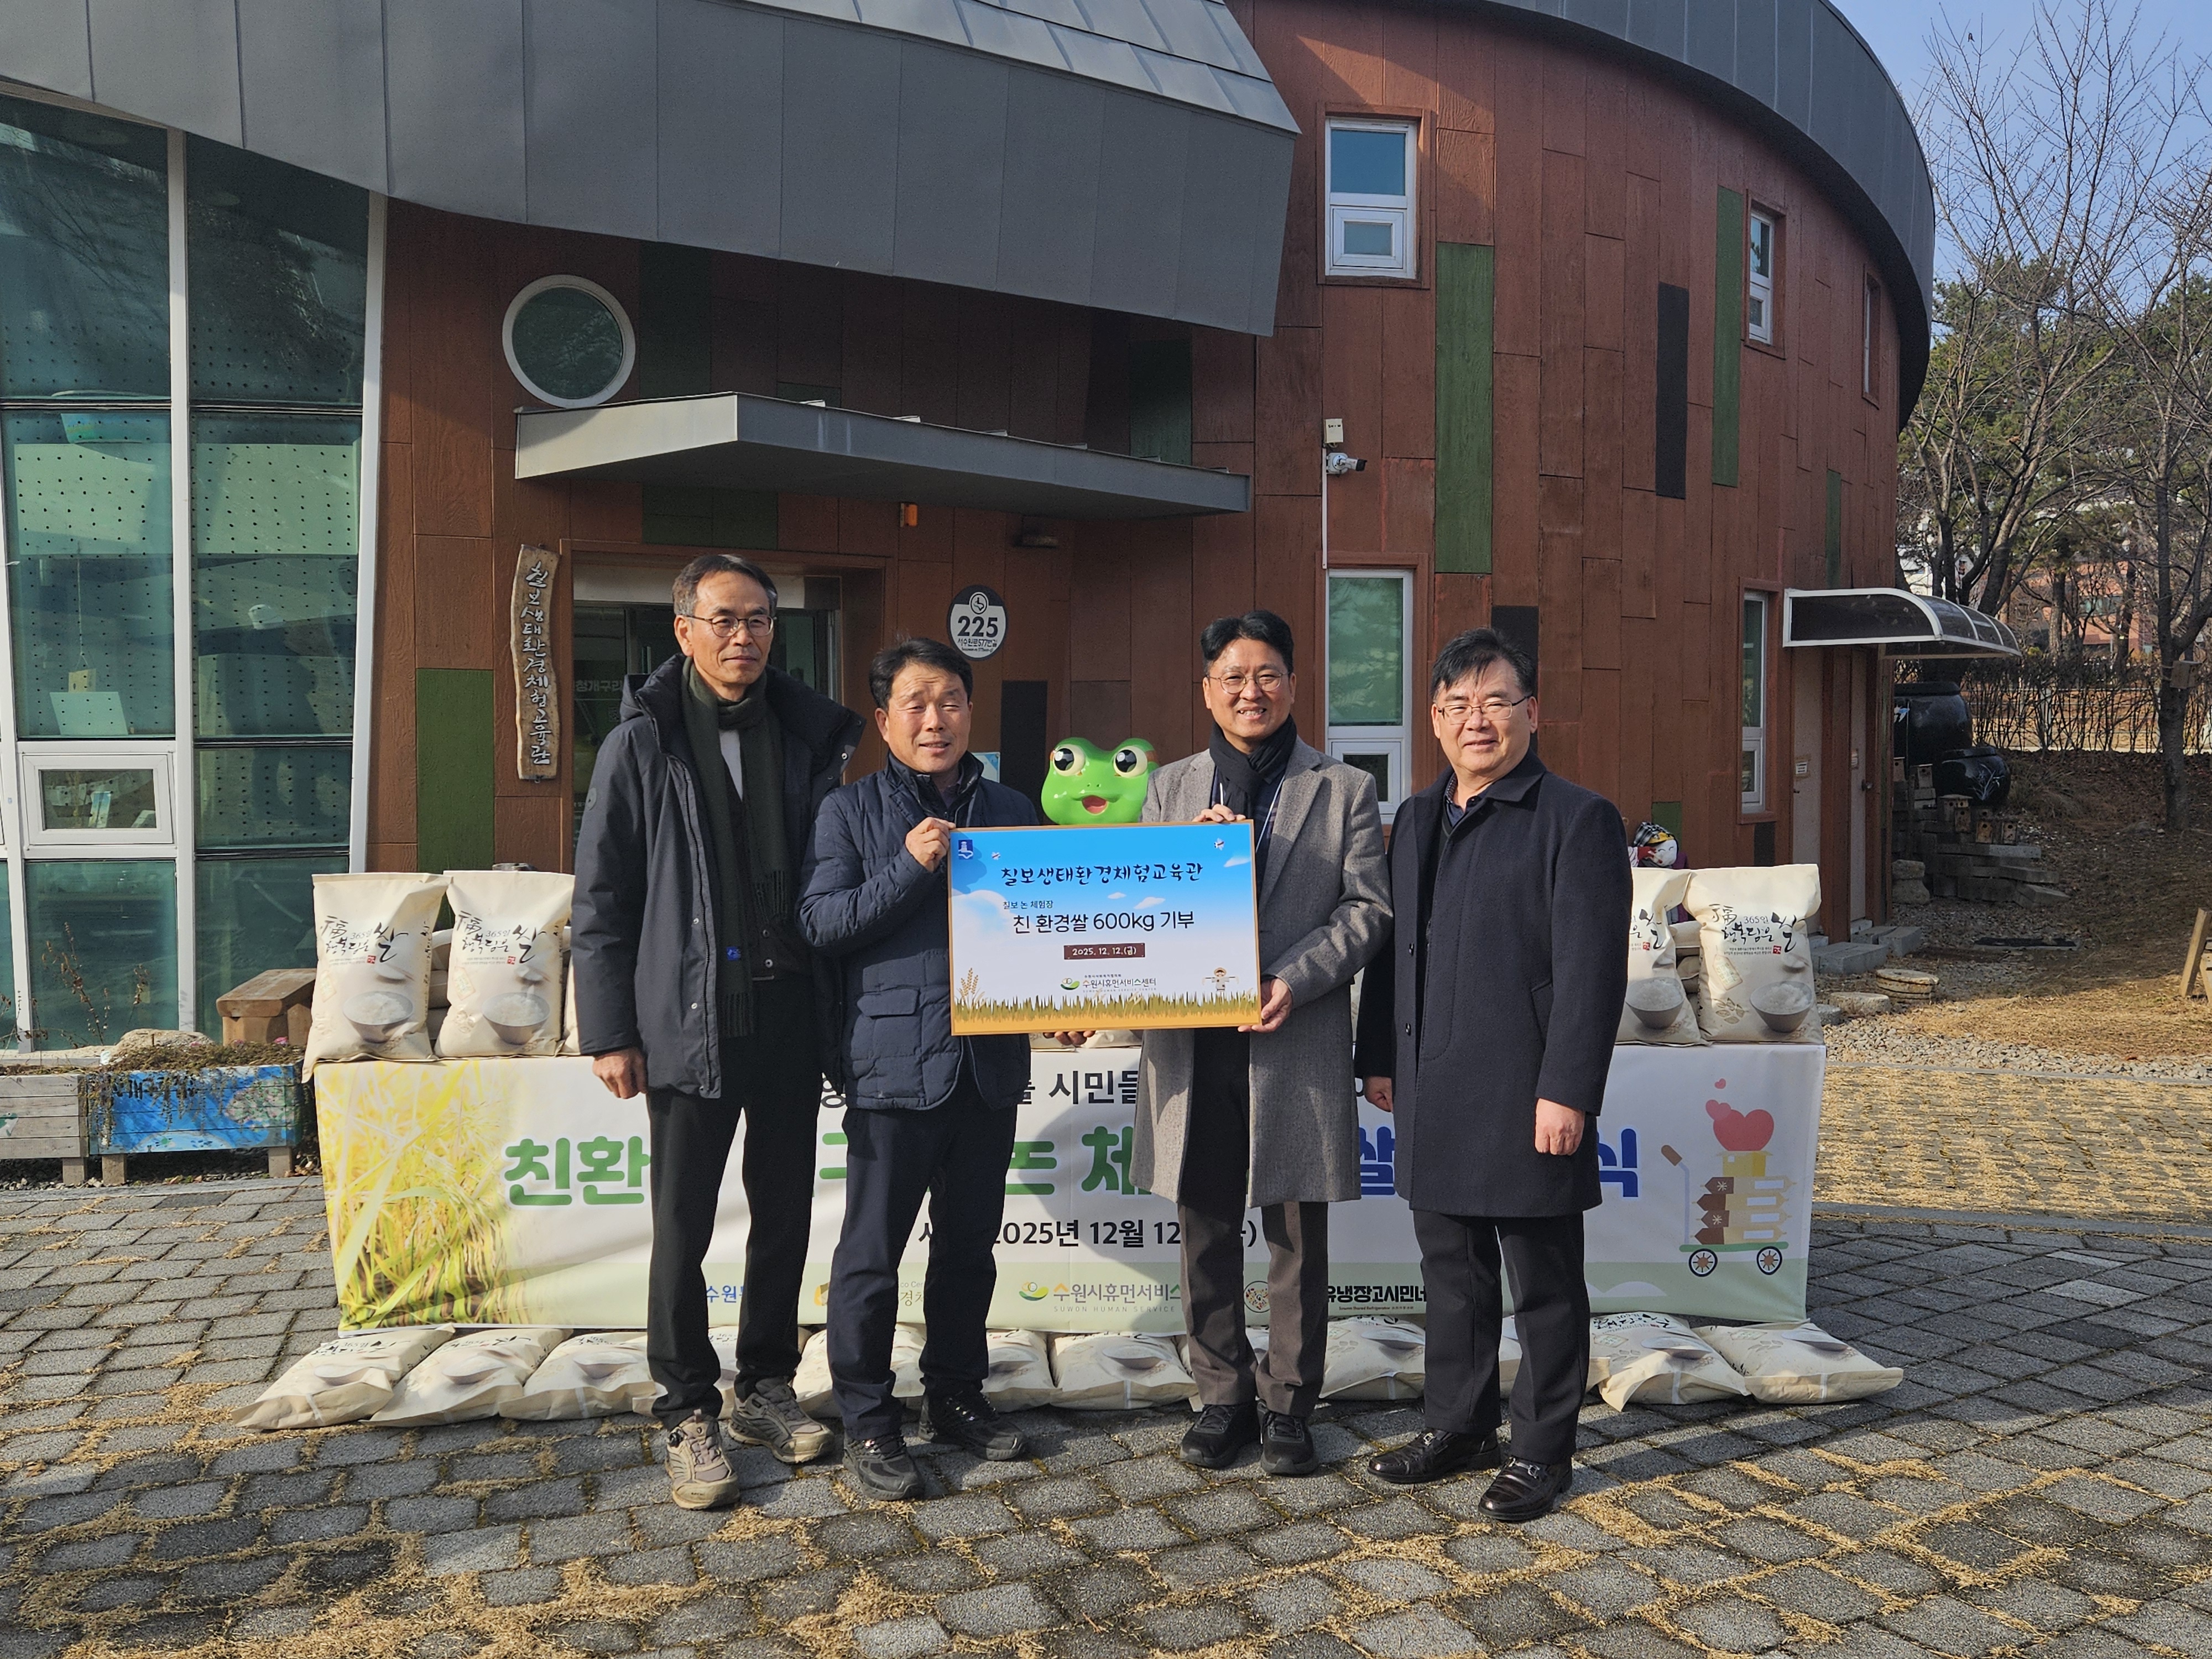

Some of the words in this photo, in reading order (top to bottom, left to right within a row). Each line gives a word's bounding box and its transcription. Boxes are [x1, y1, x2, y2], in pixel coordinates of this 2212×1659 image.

[957, 616, 998, 638] 225
[521, 561, 552, 765] 칠보생태환경체험교육관
[575, 680, 623, 692] 청개구리
[1001, 863, 1203, 886] 칠보생태환경체험교육관
[1003, 901, 1018, 910] 칠보
[1030, 900, 1053, 909] 체험장
[1013, 915, 1030, 933] 친
[1036, 914, 1088, 933] 환경쌀
[1093, 913, 1155, 932] 600kg
[1160, 911, 1194, 930] 기부
[1082, 978, 1156, 989] 수원시휴먼서비스센터
[504, 1135, 651, 1206] 친환
[1081, 1126, 1152, 1195] 체
[995, 1219, 1079, 1247] 025년
[1090, 1219, 1144, 1248] 12월
[1154, 1222, 1181, 1244] 12
[706, 1285, 744, 1303] 수원
[1053, 1284, 1181, 1303] 수원시휴먼서비스
